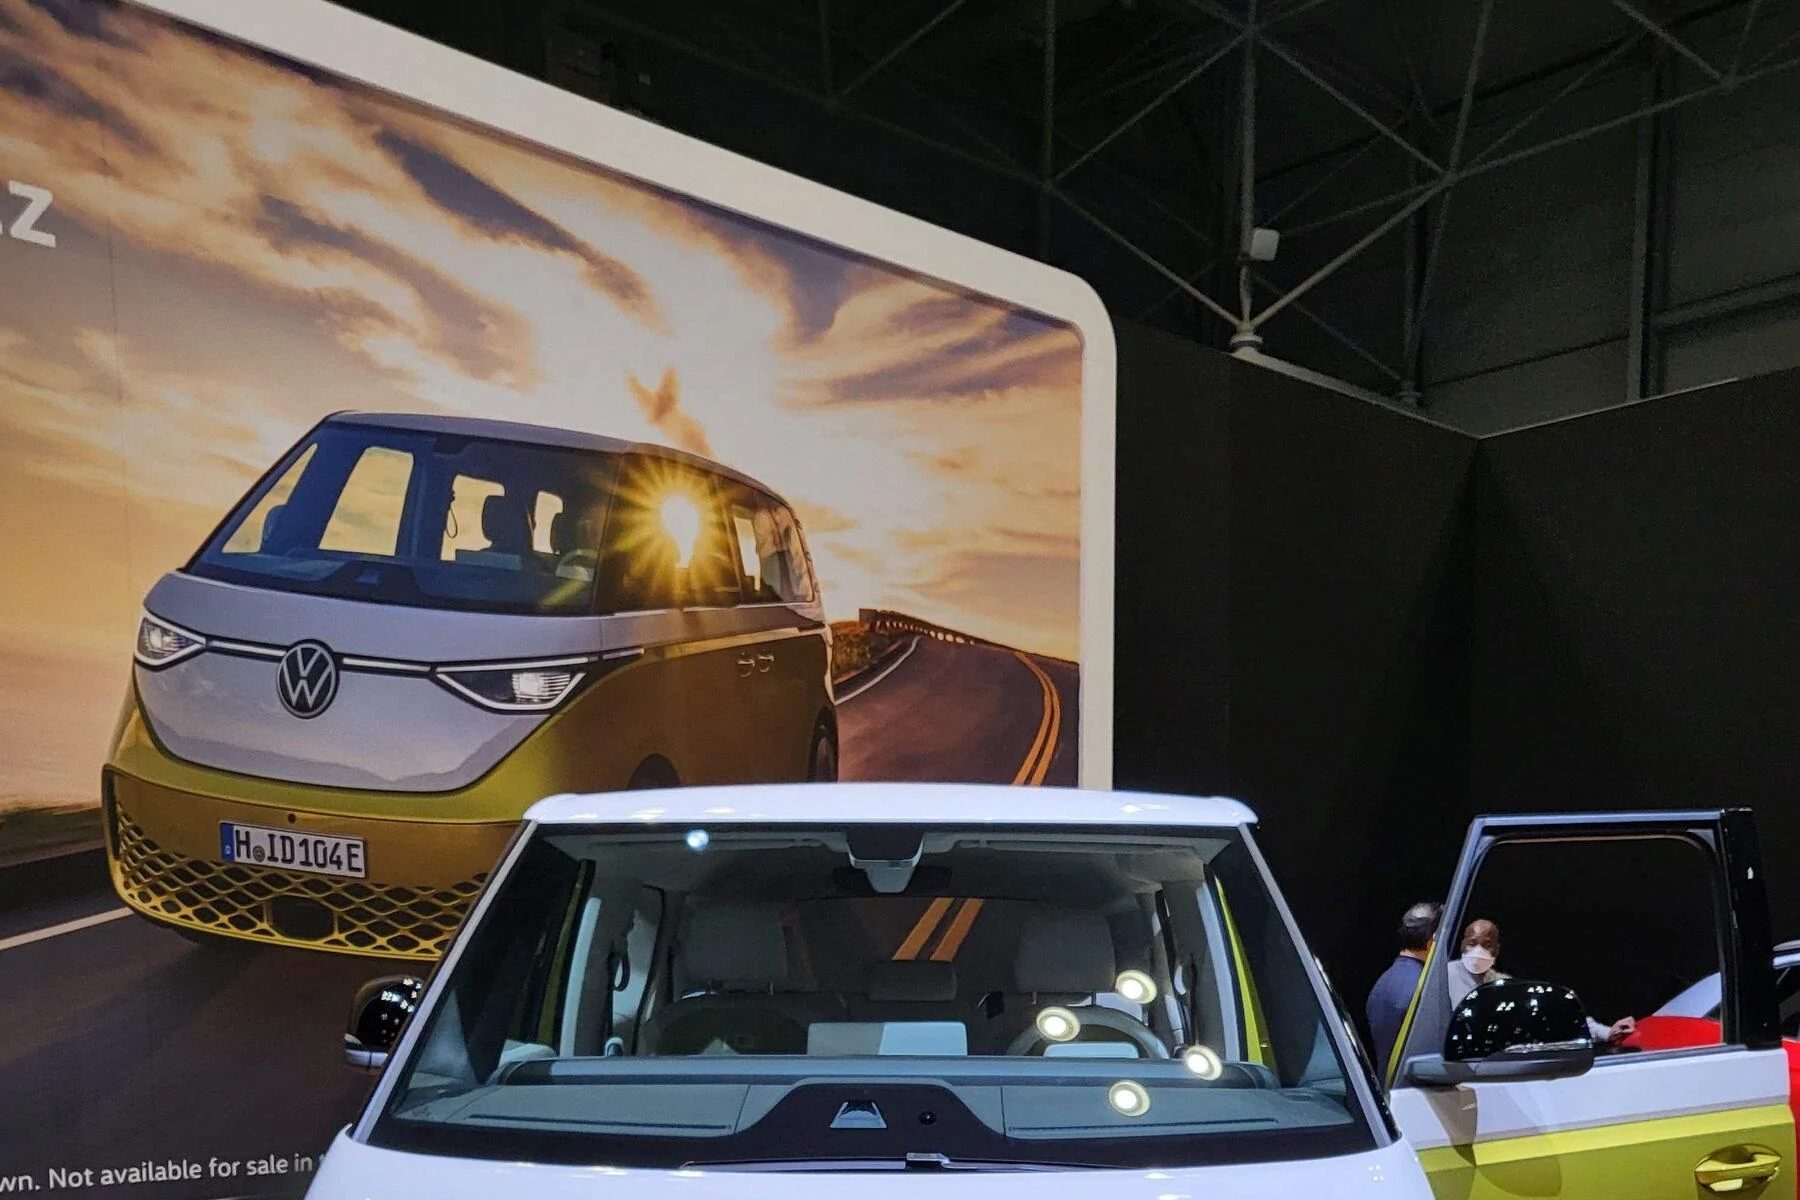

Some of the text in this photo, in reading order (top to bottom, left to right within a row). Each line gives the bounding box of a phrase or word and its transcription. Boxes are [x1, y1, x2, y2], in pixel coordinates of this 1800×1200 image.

[0, 179, 56, 248] Z
[49, 1167, 95, 1190] Not
[100, 1159, 202, 1186] available
[208, 1156, 241, 1178] for
[246, 1154, 289, 1176] sale
[294, 1152, 313, 1172] in
